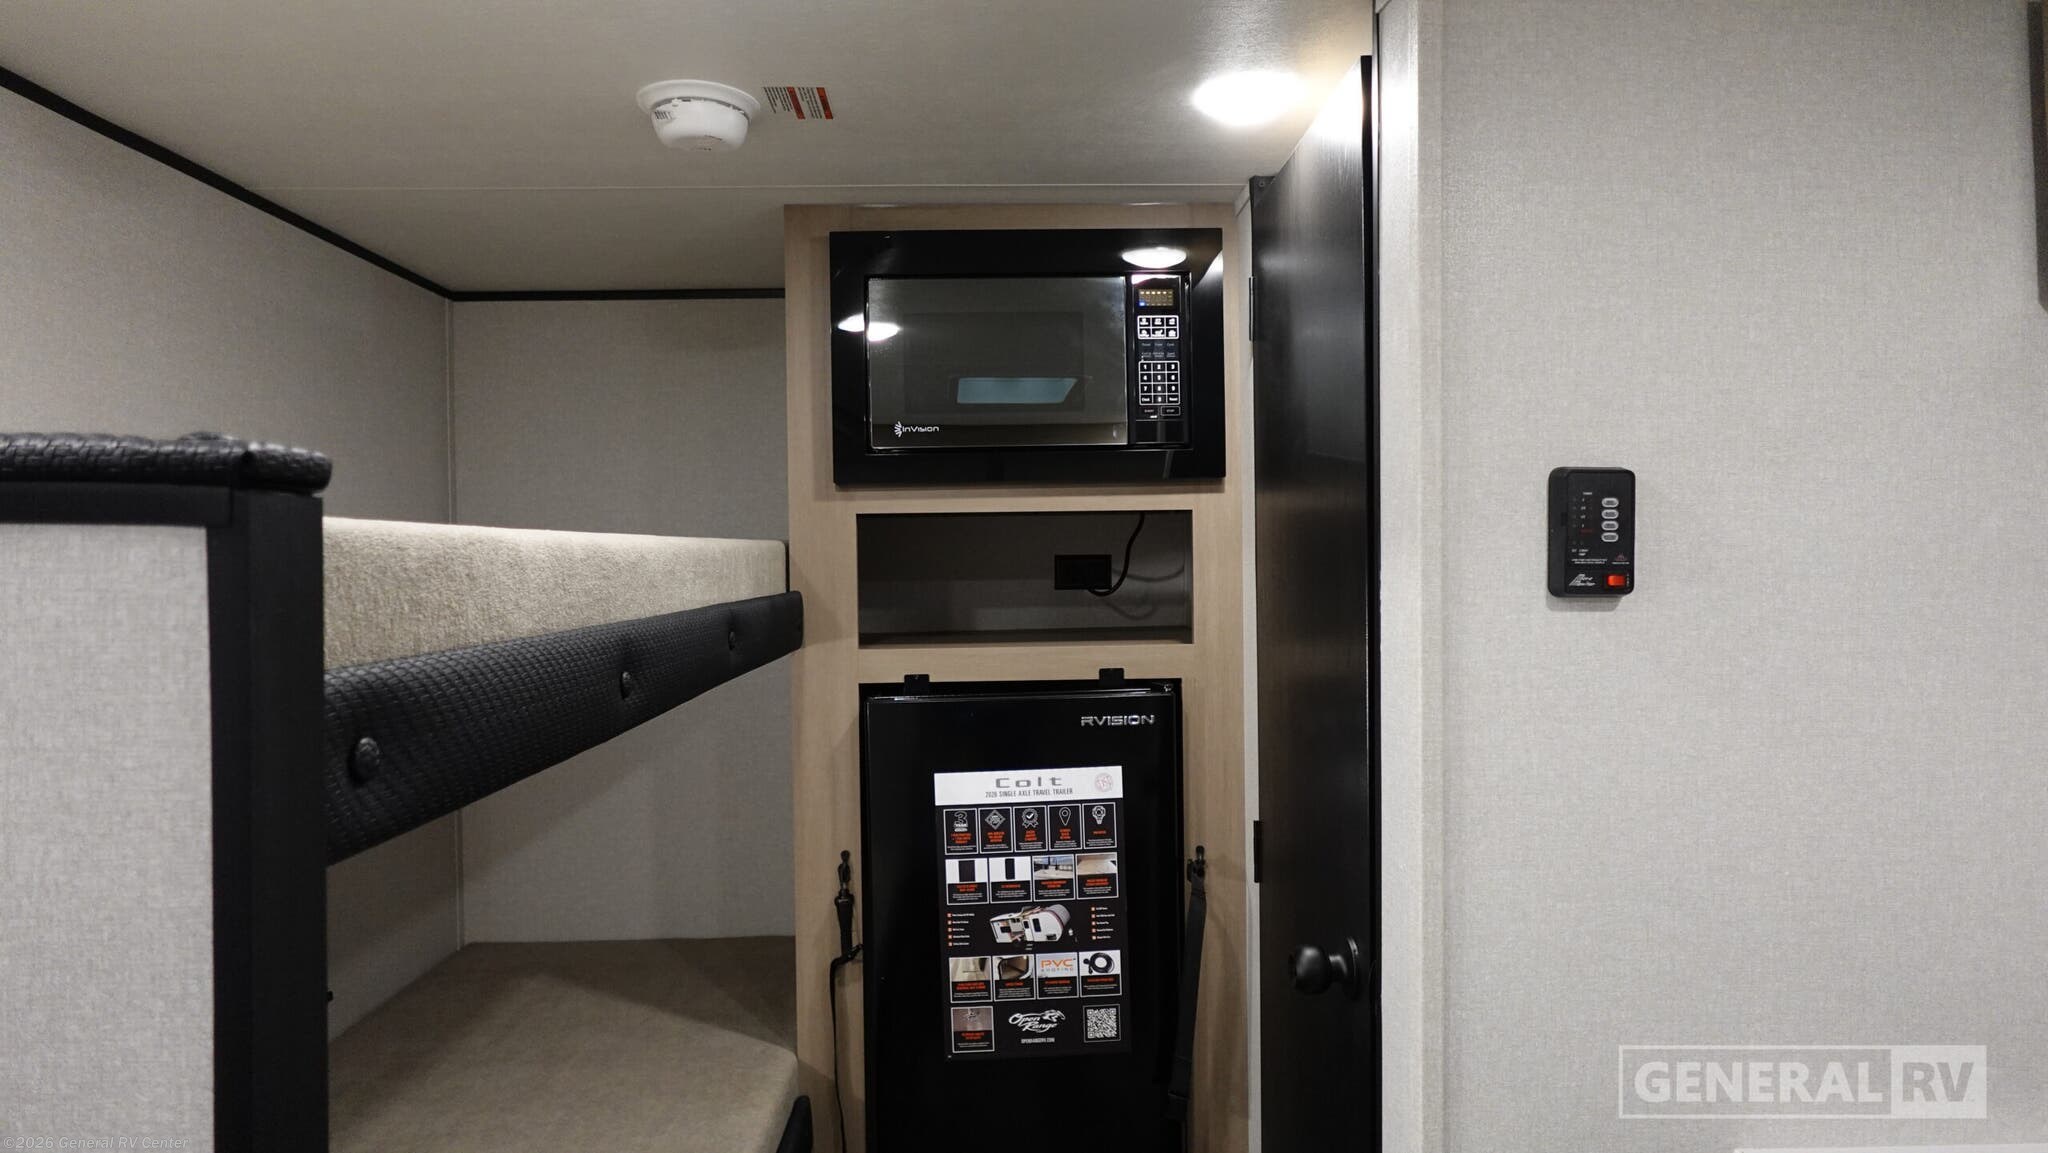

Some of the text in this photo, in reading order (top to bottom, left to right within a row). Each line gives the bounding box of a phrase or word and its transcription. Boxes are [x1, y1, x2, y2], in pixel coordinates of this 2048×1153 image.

[1080, 714, 1155, 727] RVISION
[995, 776, 1062, 789] Colt
[999, 790, 1016, 798] SINGLE
[1018, 789, 1031, 797] AXLE
[1032, 788, 1050, 796] TRAVEL
[1053, 787, 1073, 795] TRAILER
[1041, 958, 1073, 968] PVC
[1008, 1012, 1041, 1027] Open
[1020, 1021, 1058, 1033] Range
